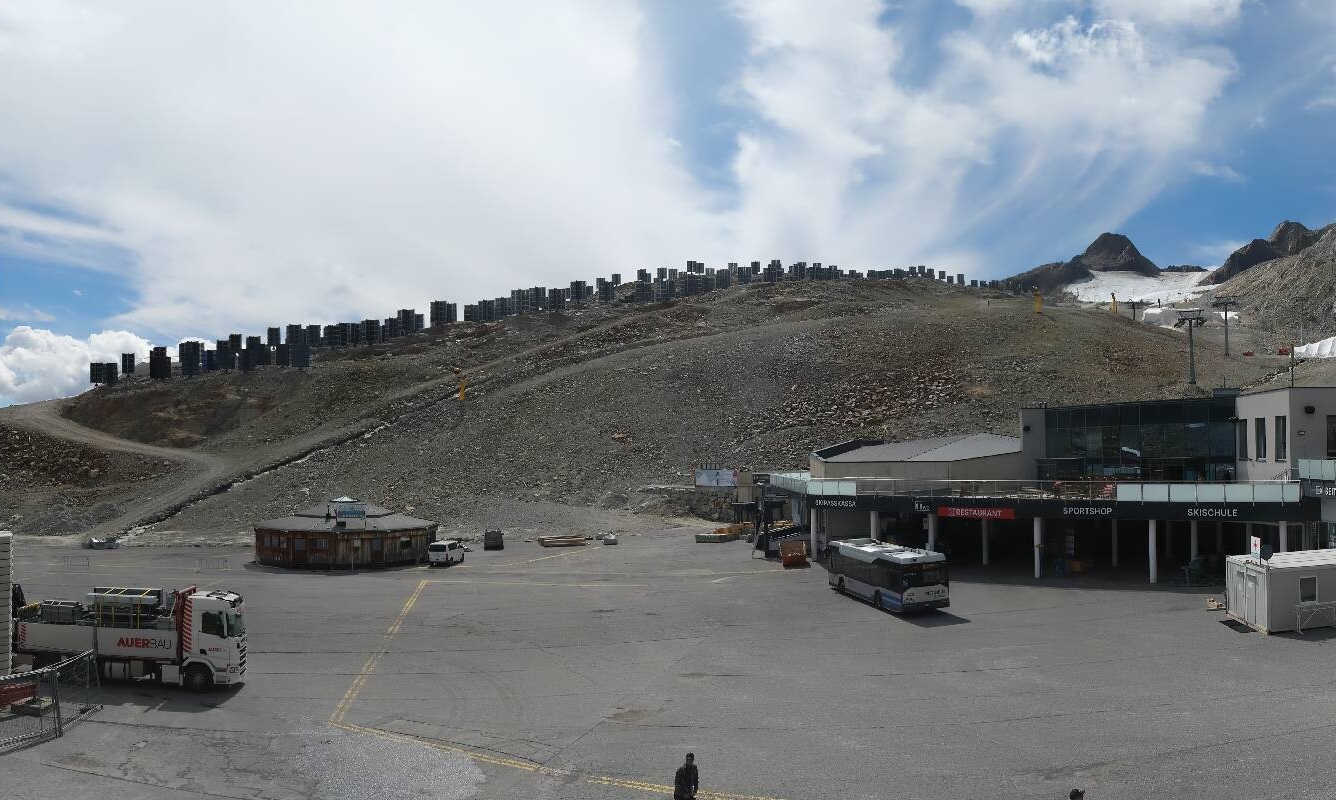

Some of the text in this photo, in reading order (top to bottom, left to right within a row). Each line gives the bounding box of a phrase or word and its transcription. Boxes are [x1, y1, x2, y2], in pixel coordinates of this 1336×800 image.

[956, 508, 1003, 517] RESTAURANT
[1063, 507, 1113, 515] SPORTSHOP
[1187, 508, 1238, 517] SKISCHULE
